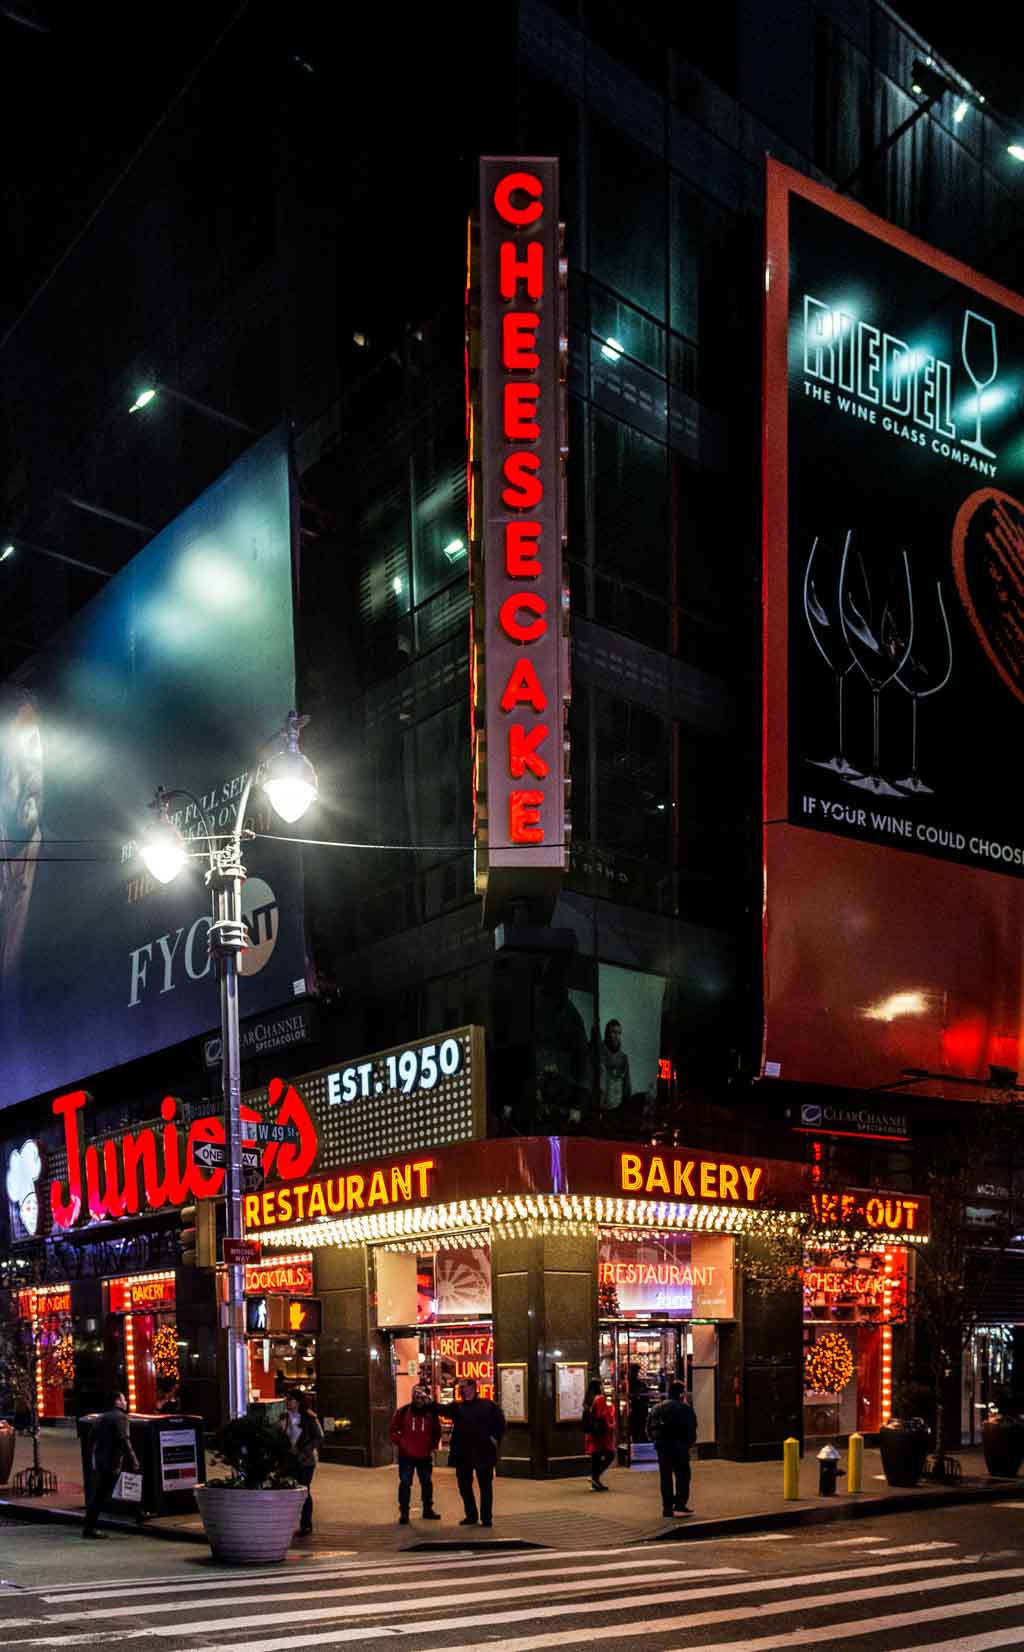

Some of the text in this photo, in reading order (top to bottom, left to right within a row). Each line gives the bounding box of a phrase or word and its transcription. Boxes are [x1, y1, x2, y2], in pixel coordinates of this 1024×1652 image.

[803, 295, 956, 440] RIEDEL
[803, 381, 998, 478] THE WINE GLASS COMPANY
[493, 172, 548, 844] CHEESECAKE
[803, 795, 1024, 866] IF YOUR WINE COULD CHOOS
[386, 1038, 460, 1094] 1950
[202, 1148, 224, 1161] ONE
[259, 1125, 269, 1139] W
[271, 1126, 284, 1141] 49
[245, 1160, 434, 1228] RESTAURANT
[620, 1153, 762, 1202] BAKERY
[132, 1284, 165, 1302] BAKERY
[245, 1267, 305, 1290] COCKTAILS
[603, 1263, 716, 1287] RESTAURANT
[440, 1337, 494, 1356] BREAKFA
